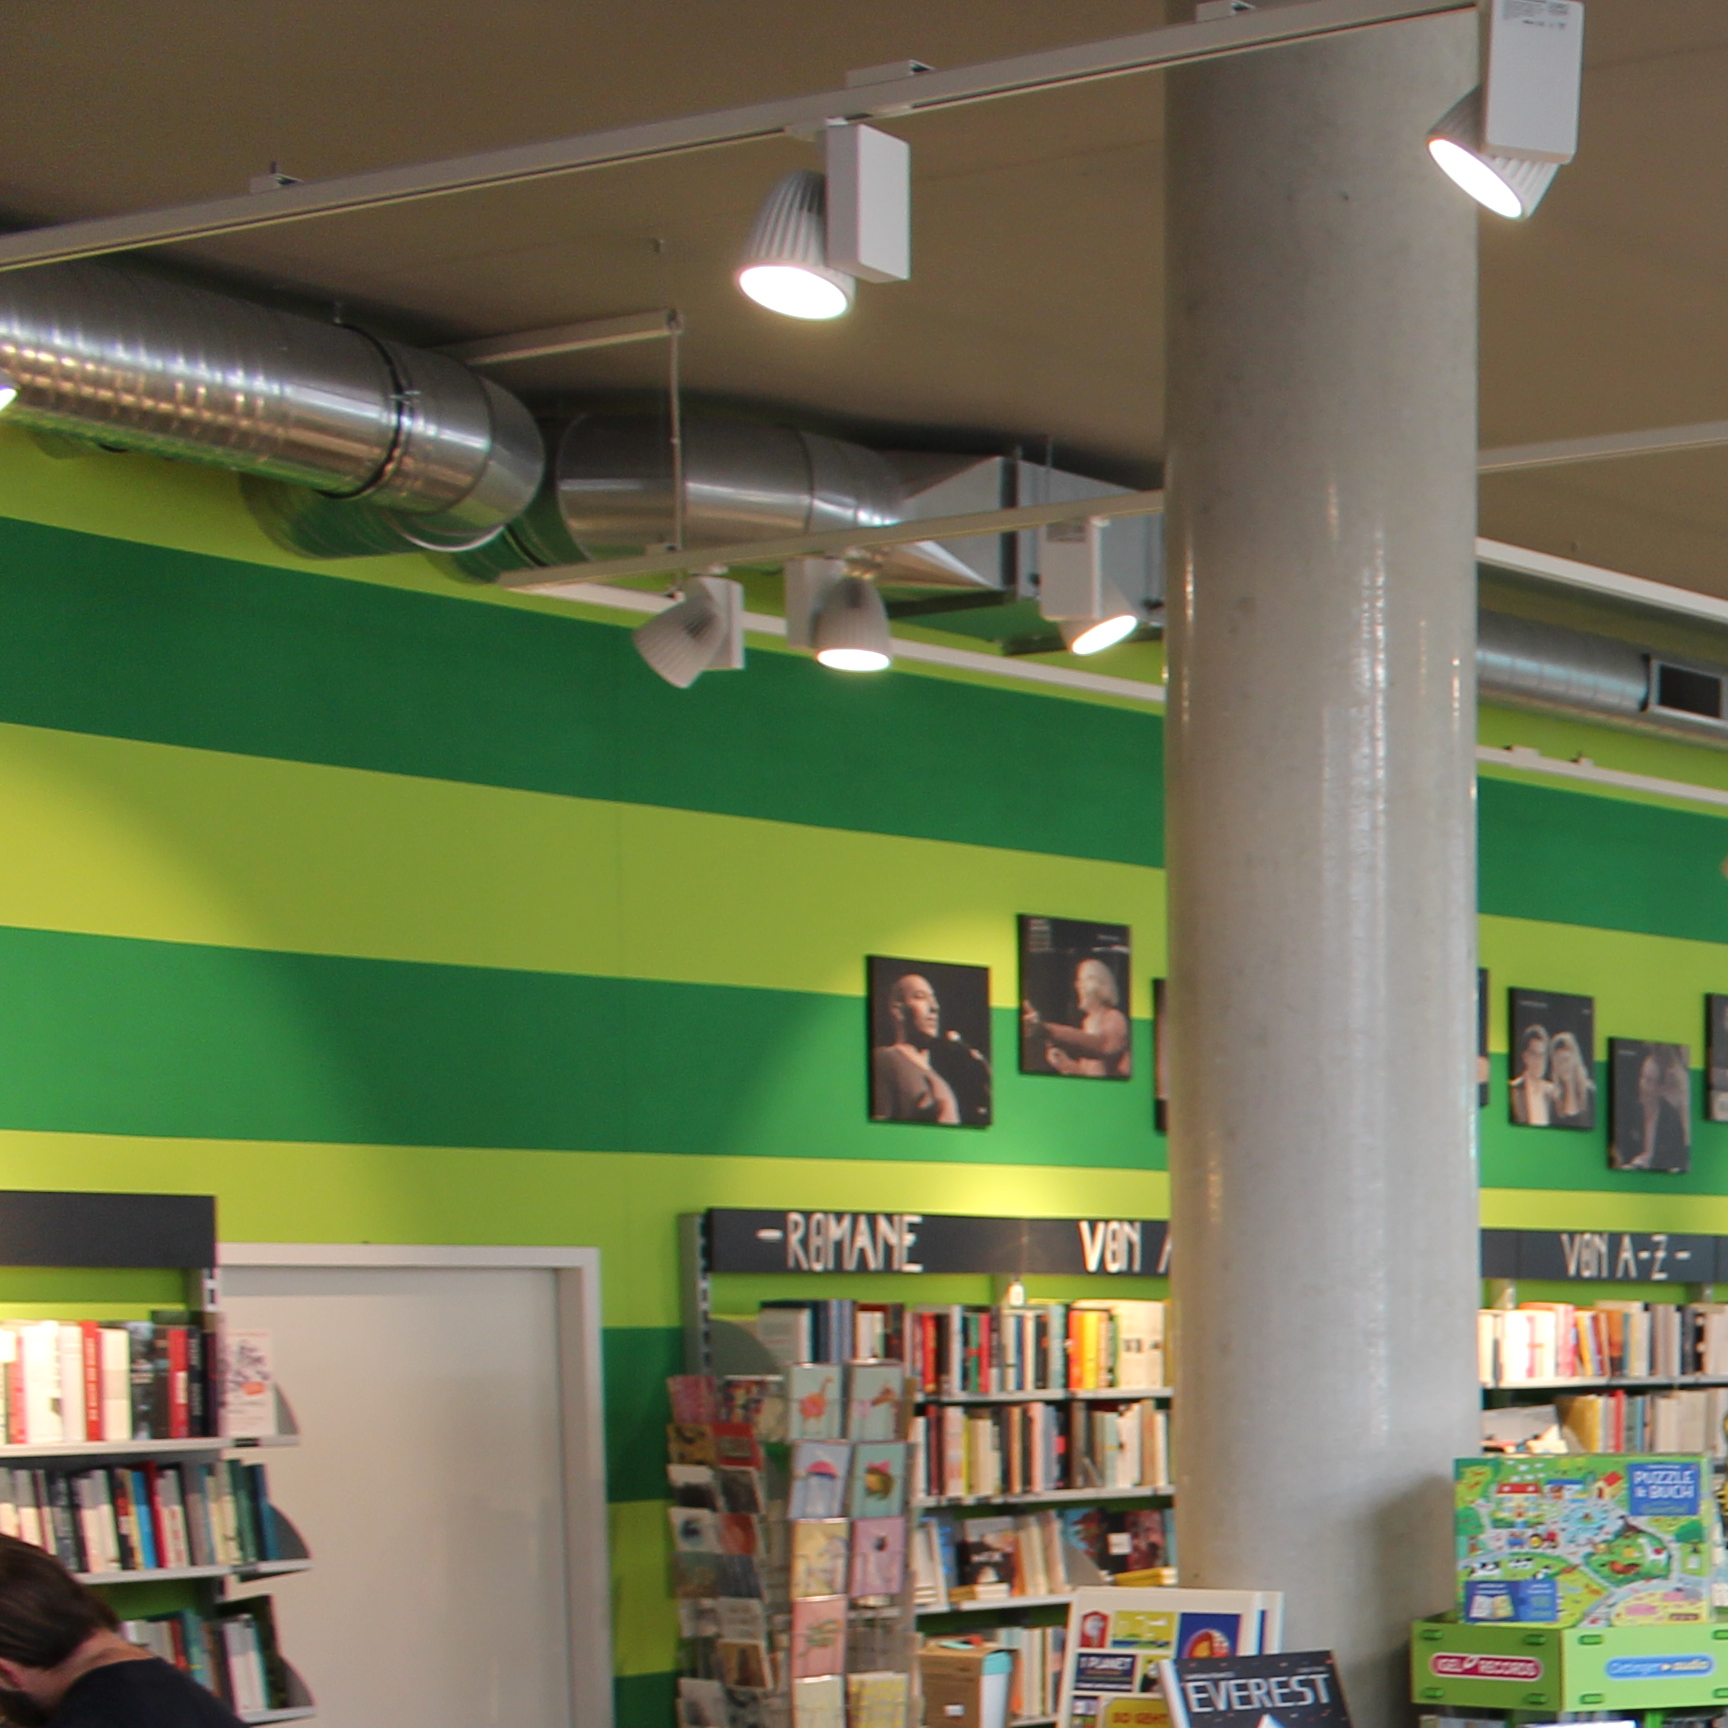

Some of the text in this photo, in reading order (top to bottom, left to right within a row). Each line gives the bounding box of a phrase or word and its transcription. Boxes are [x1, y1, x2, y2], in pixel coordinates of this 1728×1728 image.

[1079, 1220, 1142, 1273] VON
[1561, 1233, 1609, 1278] VON
[1633, 1469, 1695, 1485] PUZZLE
[1649, 1484, 1696, 1500] BUCH
[1186, 1672, 1332, 1714] EVEREST
